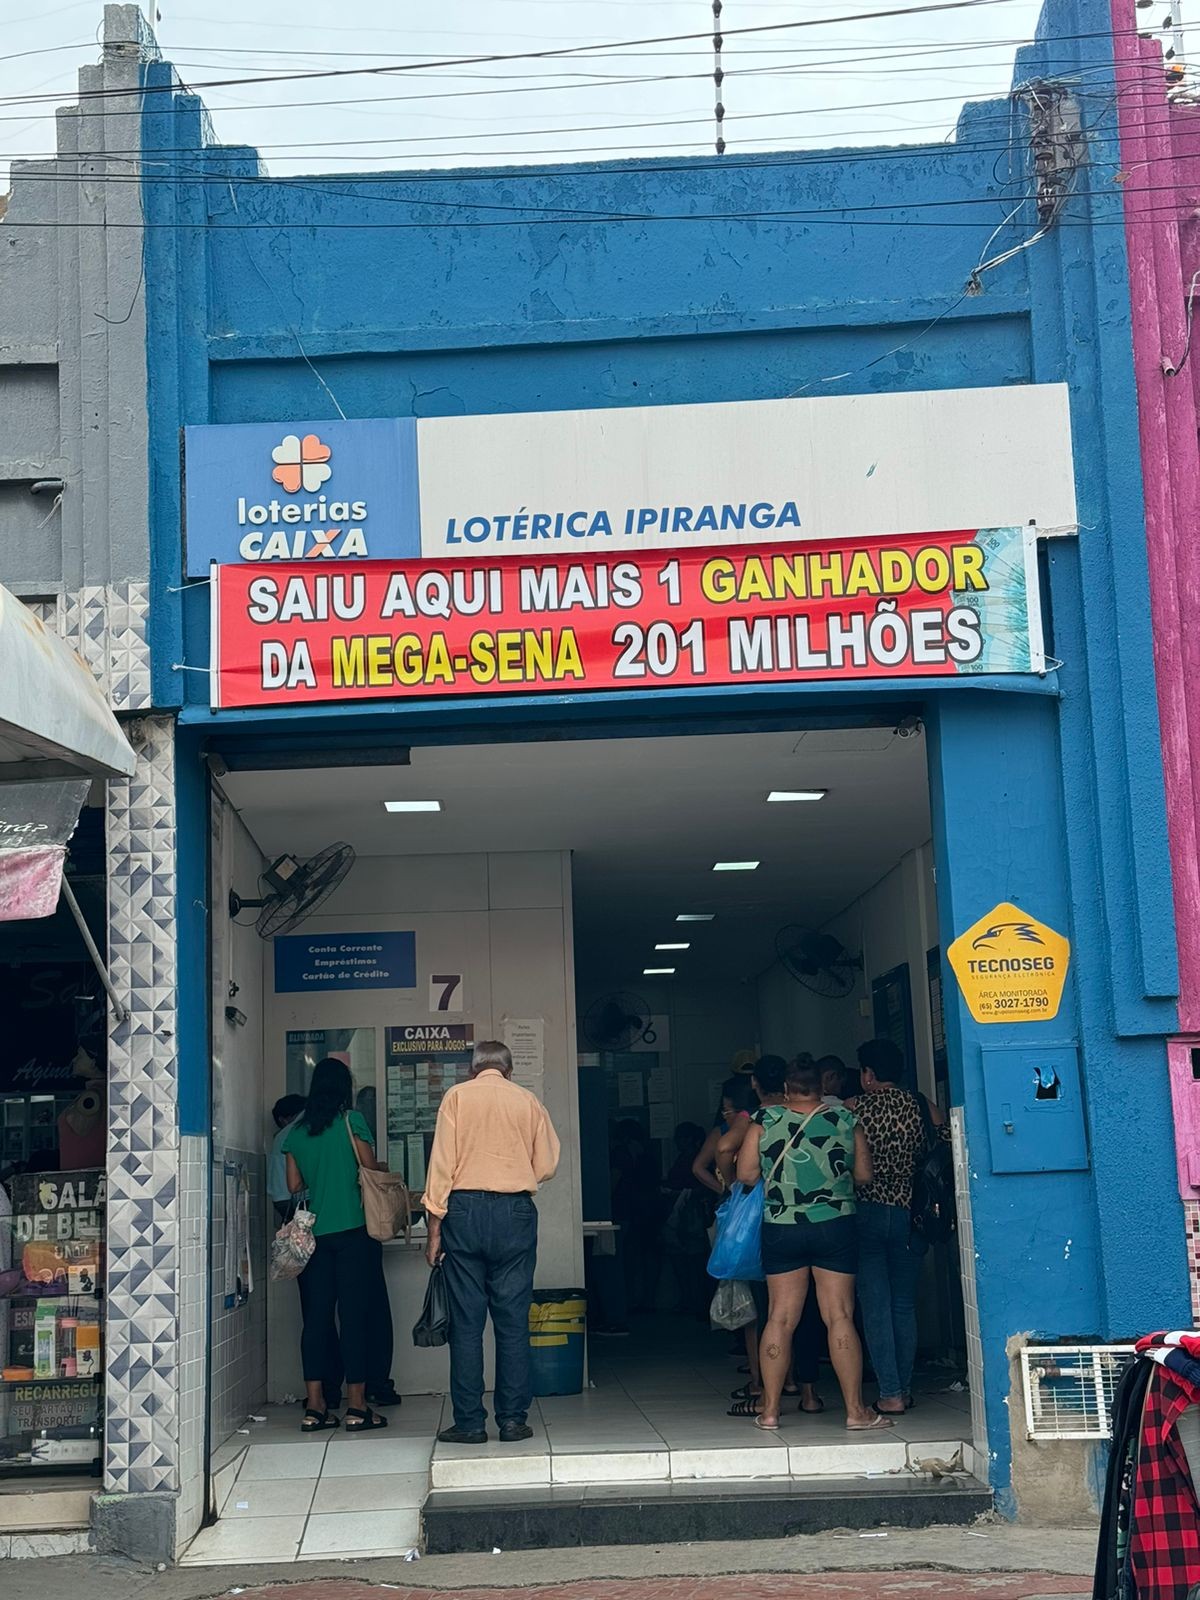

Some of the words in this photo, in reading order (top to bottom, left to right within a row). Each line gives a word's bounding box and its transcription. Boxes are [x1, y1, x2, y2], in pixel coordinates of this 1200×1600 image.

[238, 496, 367, 525] loterias
[445, 507, 613, 544] LOTÉRICA
[623, 502, 801, 534] IPIRANGA
[239, 528, 369, 561] CAIXA
[247, 573, 366, 624] SAIU
[380, 566, 503, 620] AQUI
[519, 561, 644, 613] MAIS
[658, 559, 682, 606] 1
[700, 544, 990, 603] GANHADOR
[260, 639, 318, 691] DA
[331, 627, 585, 689] MEGA-SENA
[613, 618, 707, 679] 201
[729, 600, 984, 674] MILHÕES
[315, 957, 377, 967] Empréstimos
[967, 957, 1055, 973] TECNOSEG
[302, 972, 335, 980] Cartão
[338, 971, 351, 979] de
[353, 970, 390, 978] Crédito
[431, 975, 462, 1011] 7
[999, 989, 1048, 997] MONITORADA
[979, 1002, 993, 1011] (65)
[994, 997, 1049, 1009] 3027-1790
[404, 1026, 450, 1039] CAIXA
[642, 1021, 657, 1044] 6
[392, 1041, 427, 1052] EXCLUSIVO
[427, 1040, 443, 1051] PARA
[444, 1040, 466, 1050] JOGOS
[16, 1213, 49, 1241] DE
[12, 1405, 33, 1416] SEU
[77, 1402, 89, 1413] DE
[17, 1415, 82, 1427] TRANSPORTE
